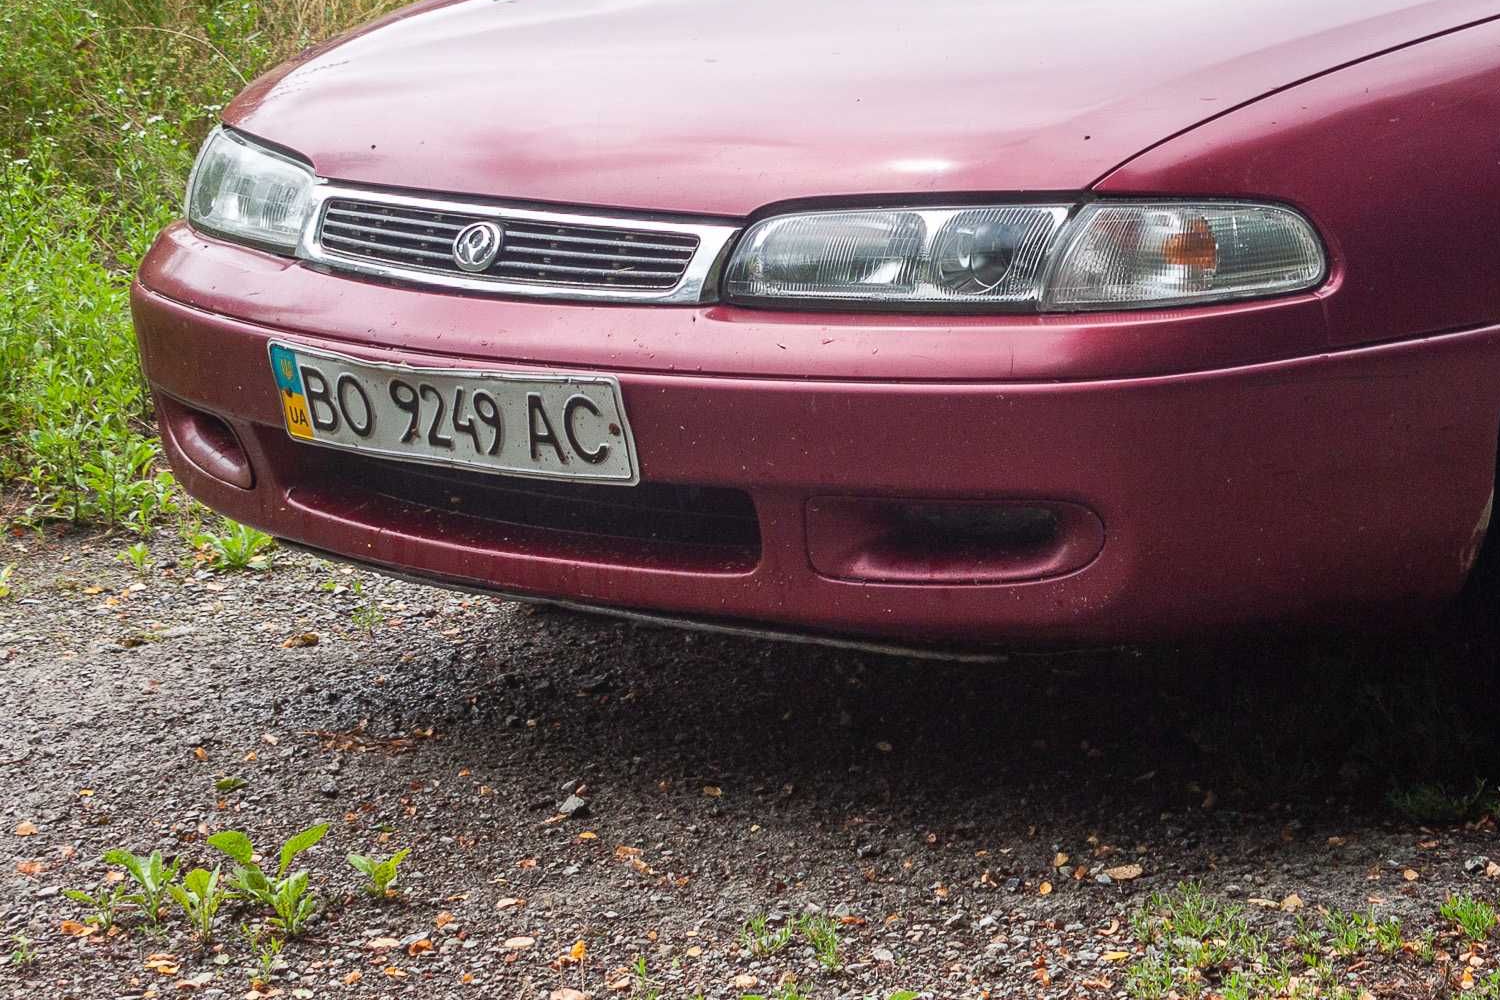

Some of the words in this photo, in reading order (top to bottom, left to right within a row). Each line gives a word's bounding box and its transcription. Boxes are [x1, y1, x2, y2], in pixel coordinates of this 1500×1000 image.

[289, 406, 309, 427] UA
[300, 365, 374, 437] BO
[389, 379, 502, 455] 9249
[527, 393, 610, 464] AC
